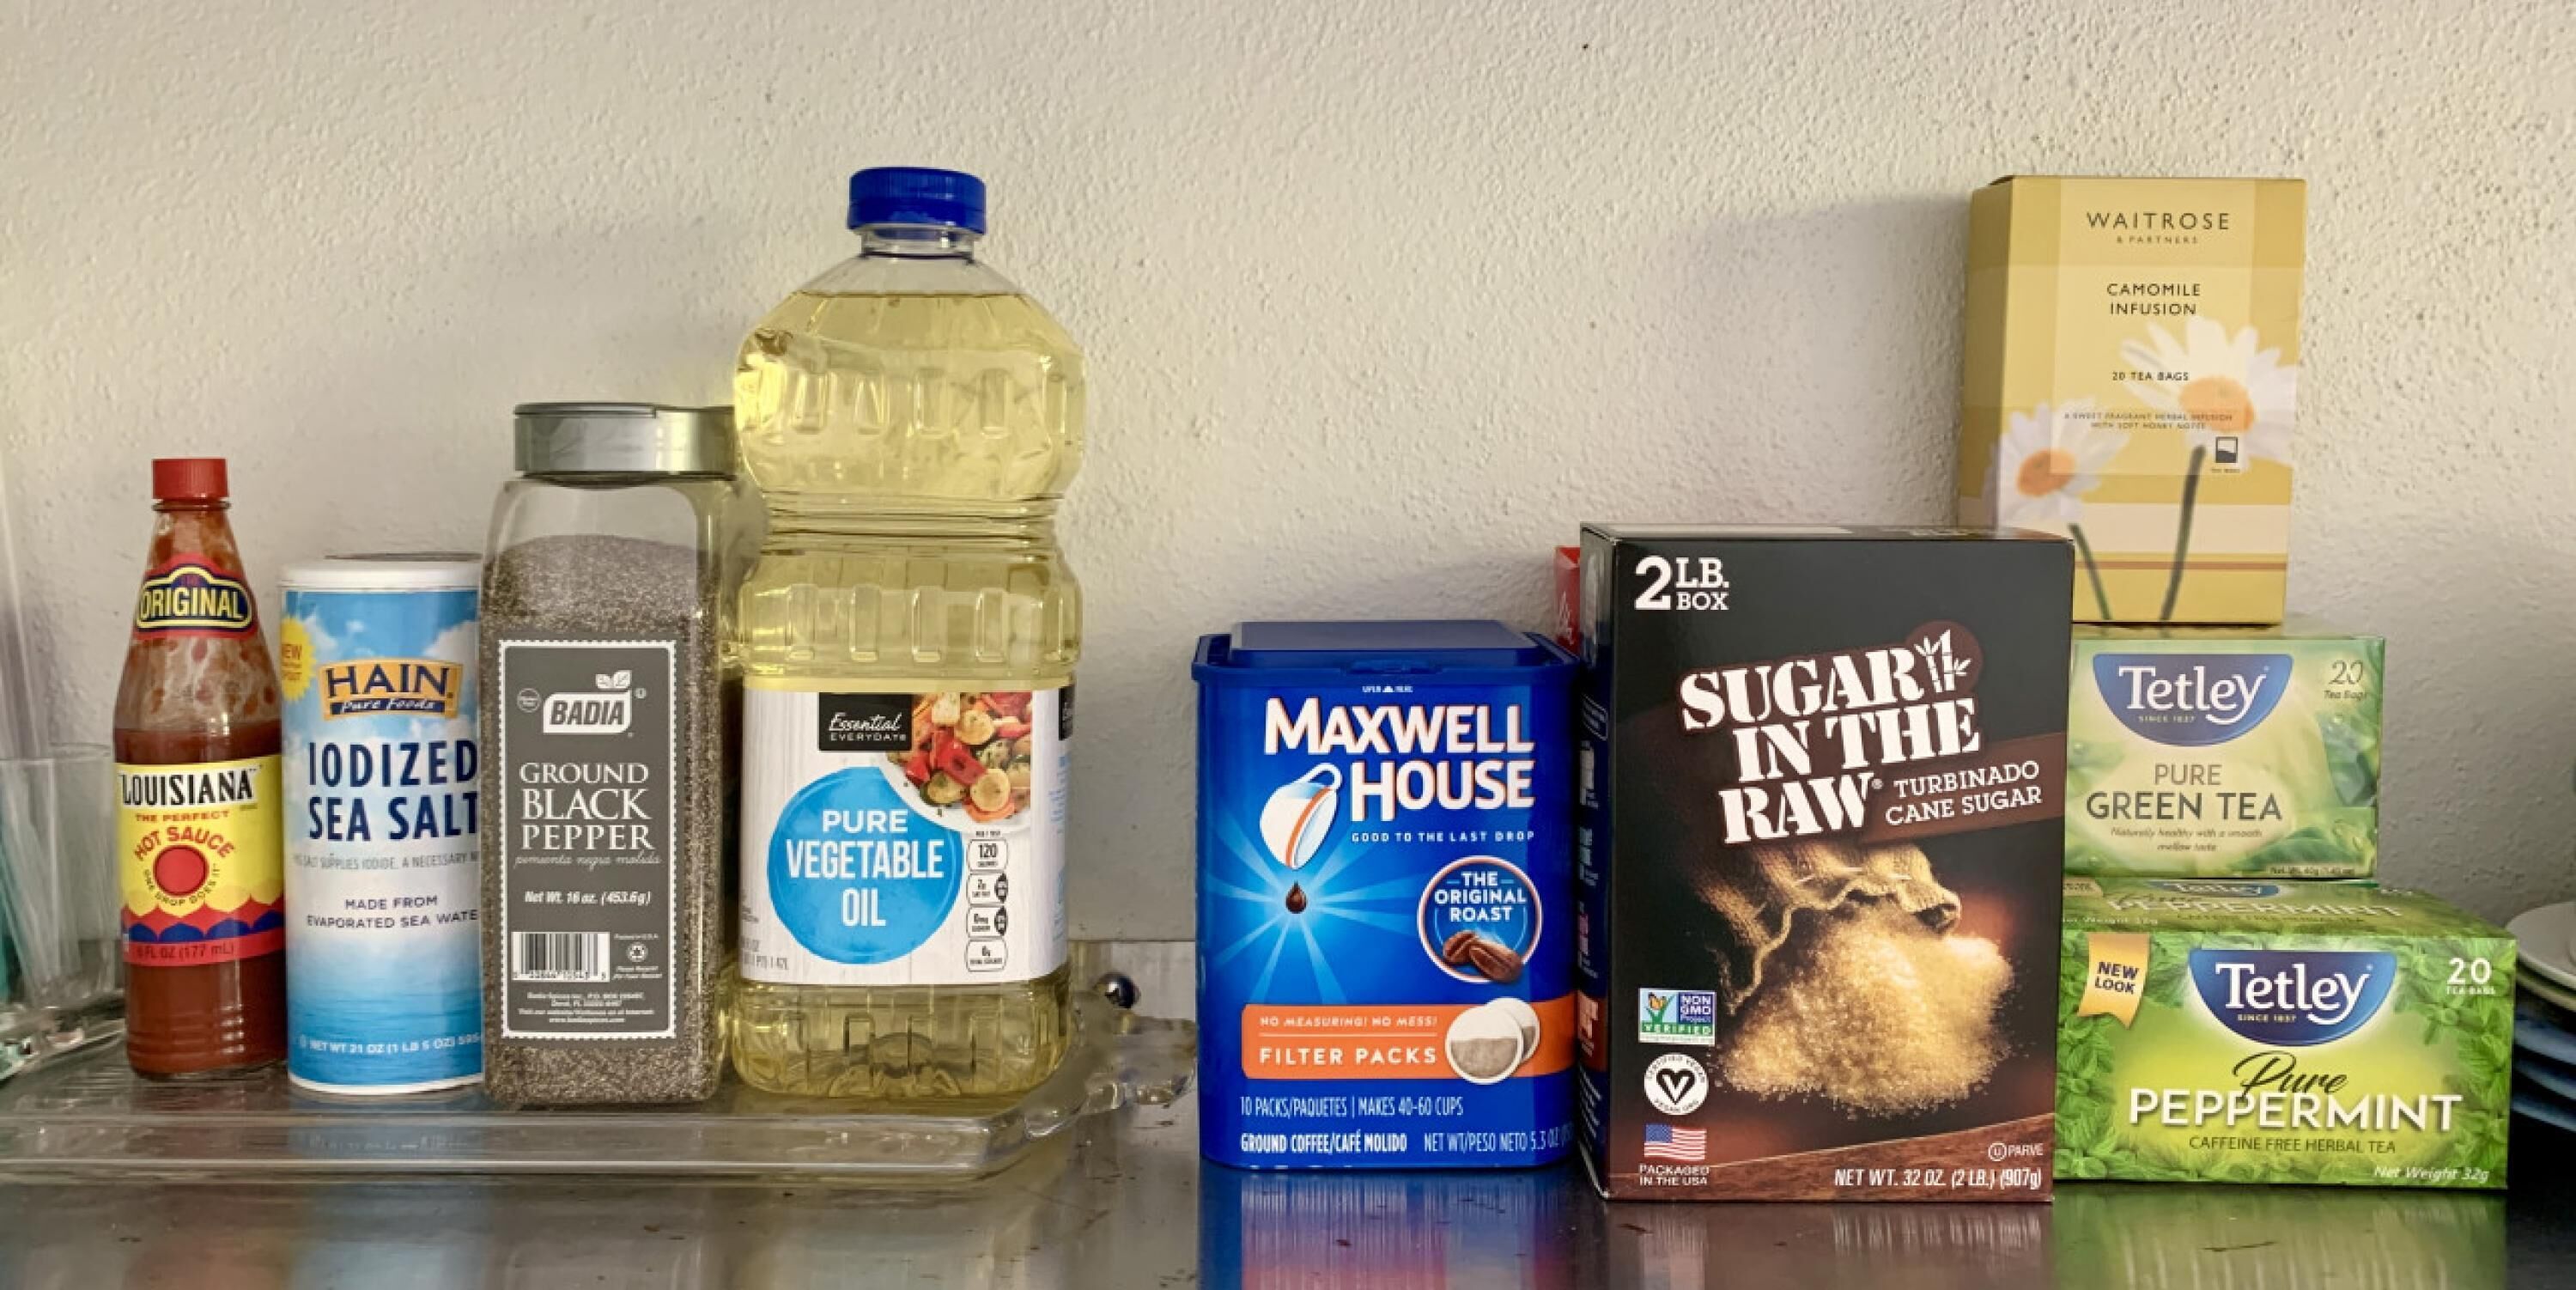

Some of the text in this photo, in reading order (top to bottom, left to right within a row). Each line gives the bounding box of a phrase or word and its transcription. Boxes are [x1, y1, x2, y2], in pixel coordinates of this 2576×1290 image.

[2087, 212, 2230, 230] WAITROSE
[2129, 235, 2198, 244] PARTNERS
[2106, 283, 2201, 296] CAMOMILE
[2110, 302, 2196, 315] INFUSION
[2111, 372, 2189, 381] 20 TEA BAGS
[1634, 555, 1729, 611] 2 LB.
[140, 587, 244, 620] ORIGINAL
[1675, 592, 1729, 611] BOX
[325, 664, 449, 697] HAIN
[2329, 660, 2363, 685] 20
[1680, 647, 1925, 732] SUGAR
[2118, 665, 2267, 726] Tetley
[550, 700, 625, 726] BADIA
[828, 711, 902, 732] Essential
[1265, 697, 1535, 755] MAXWELL
[829, 733, 908, 742] EVERYDAY
[1733, 697, 1980, 782] IN THE
[309, 739, 477, 787] IODIZED
[519, 762, 650, 784] GROUND
[1893, 760, 2039, 799] TURBINADO
[2154, 764, 2222, 786] PURE
[1351, 760, 1536, 822] HOUSE
[521, 788, 654, 820] BLACK
[1885, 786, 2043, 827] CANE SUGAR
[2087, 792, 2283, 821] GREEN TEA
[136, 810, 230, 822] THE PERFECT
[309, 791, 477, 841] SEA SALT
[822, 810, 908, 833] PURE
[135, 826, 235, 861] HOT SAUCE
[521, 825, 656, 850] PEPPER
[1352, 831, 1534, 843] GOOD TO THE LAST DROP
[2111, 827, 2156, 840] Naturally
[2158, 827, 2193, 840] healthy
[786, 838, 945, 879] VEGETABLE
[978, 843, 998, 858] 120
[1461, 872, 1498, 886] THE
[345, 895, 438, 910] MADE FROM
[525, 891, 544, 903] Net
[1434, 888, 1527, 904] ORIGINAL
[841, 887, 887, 927] OIL
[1449, 906, 1513, 922] ROAST
[307, 909, 478, 928] EVAPORATED SEA WATE
[2097, 961, 2140, 981] NEW
[2447, 958, 2492, 984] 20
[2094, 977, 2136, 995] LOOK
[2215, 962, 2370, 1025] Tetley
[1680, 1006, 1711, 1015] GMO
[1681, 995, 1711, 1005] NON
[1260, 1017, 1437, 1027] NO MEASURING! NO MESS!
[1644, 1024, 1712, 1036] VERIFIED
[1259, 1046, 1437, 1066] FILTER PACKS
[2232, 1050, 2350, 1103] Pure
[1241, 1097, 1464, 1119] 10 PACKS/PAQUETES MAKES 40-60 CUPS
[2129, 1087, 2464, 1134] PEPPERMINT
[1241, 1129, 1407, 1155] GROUND COFFEE/CAFÉ MOLIDO
[1424, 1132, 1444, 1152] NET
[1447, 1131, 1496, 1153] WT/PESO
[1499, 1132, 1528, 1152] NETO
[1531, 1130, 1546, 1150] 5.3
[2008, 1142, 2044, 1157] PARVE
[2190, 1136, 2396, 1154] CAFFEINE FREE HERBAL TEA
[1639, 1165, 1710, 1176] PACKAGED
[1640, 1176, 1708, 1186] IN THE USA
[1834, 1169, 2042, 1190] NET WT. 32 OZ. (2 LB.) (907g)
[2373, 1165, 2490, 1184] Net Weight 32g
